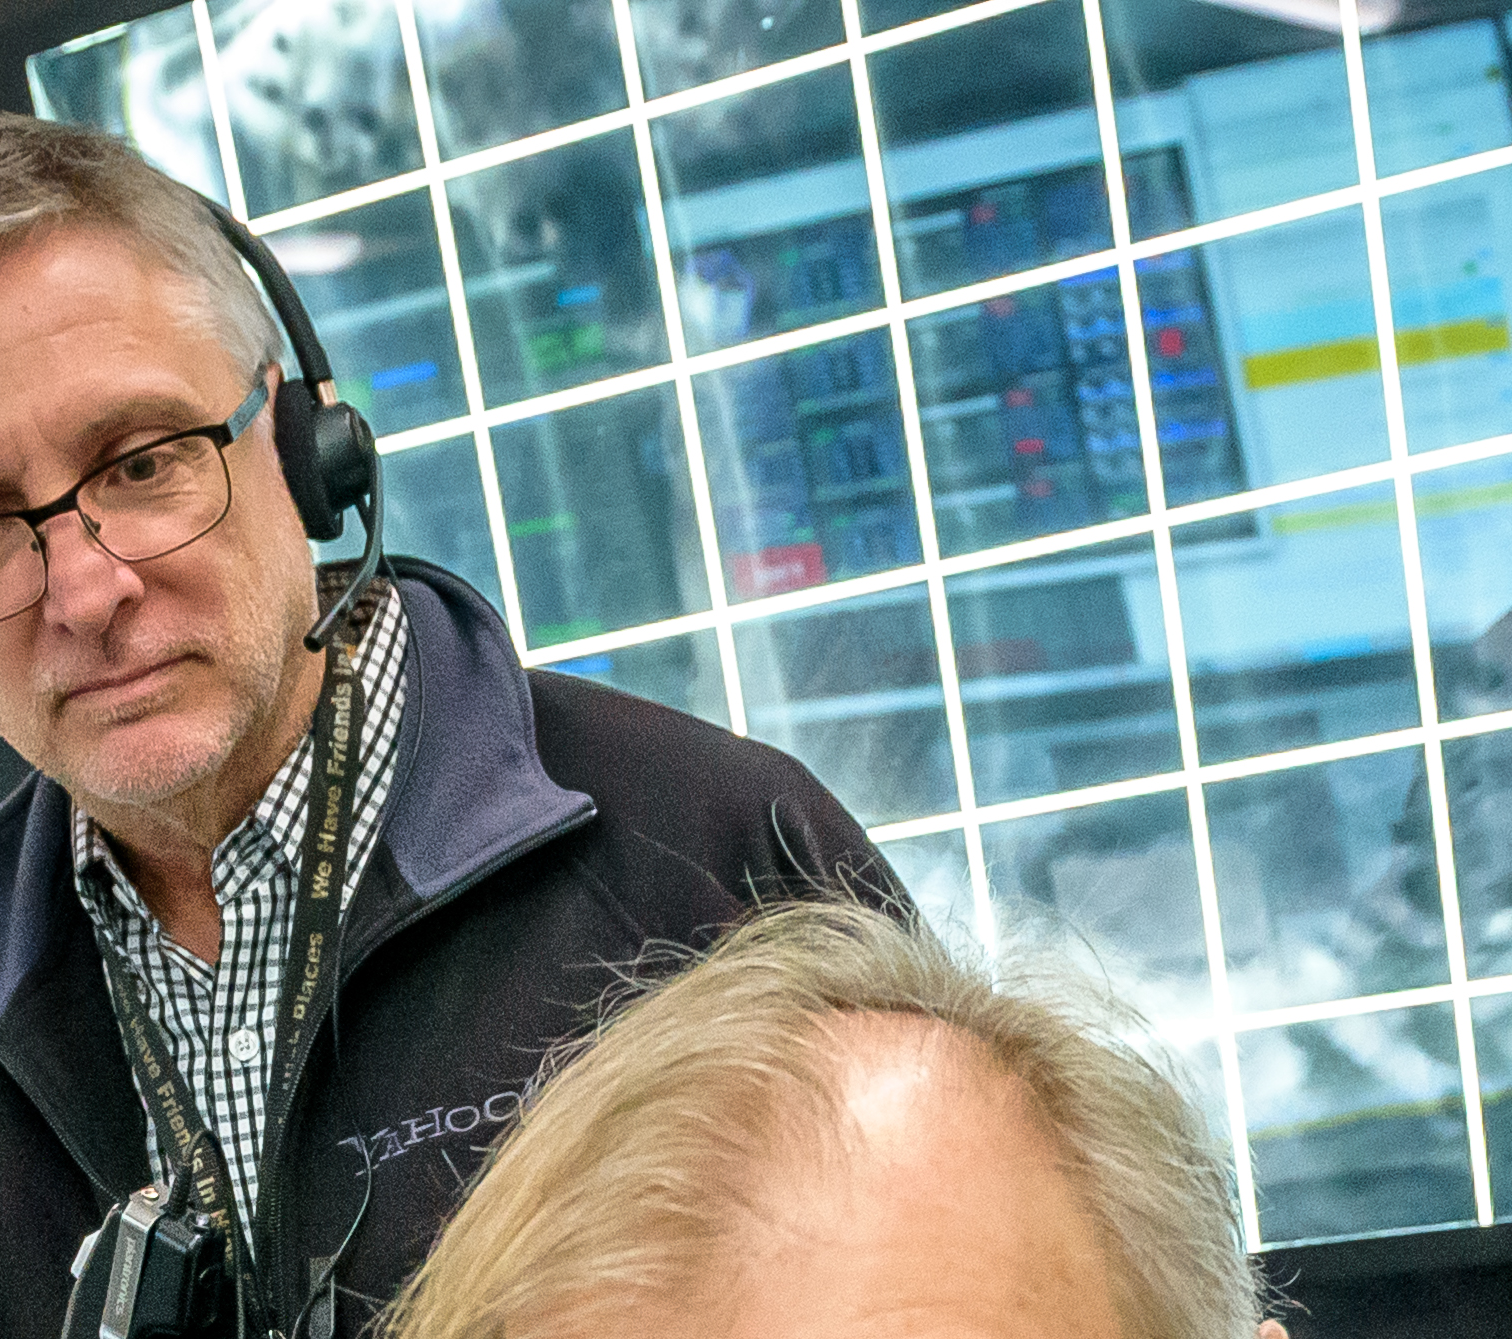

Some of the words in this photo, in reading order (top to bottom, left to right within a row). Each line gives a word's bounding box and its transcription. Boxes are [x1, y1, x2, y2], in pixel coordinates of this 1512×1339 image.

[327, 683, 351, 776] Friends
[317, 786, 341, 852] Have
[311, 860, 332, 898] We
[196, 1176, 216, 1204] In
